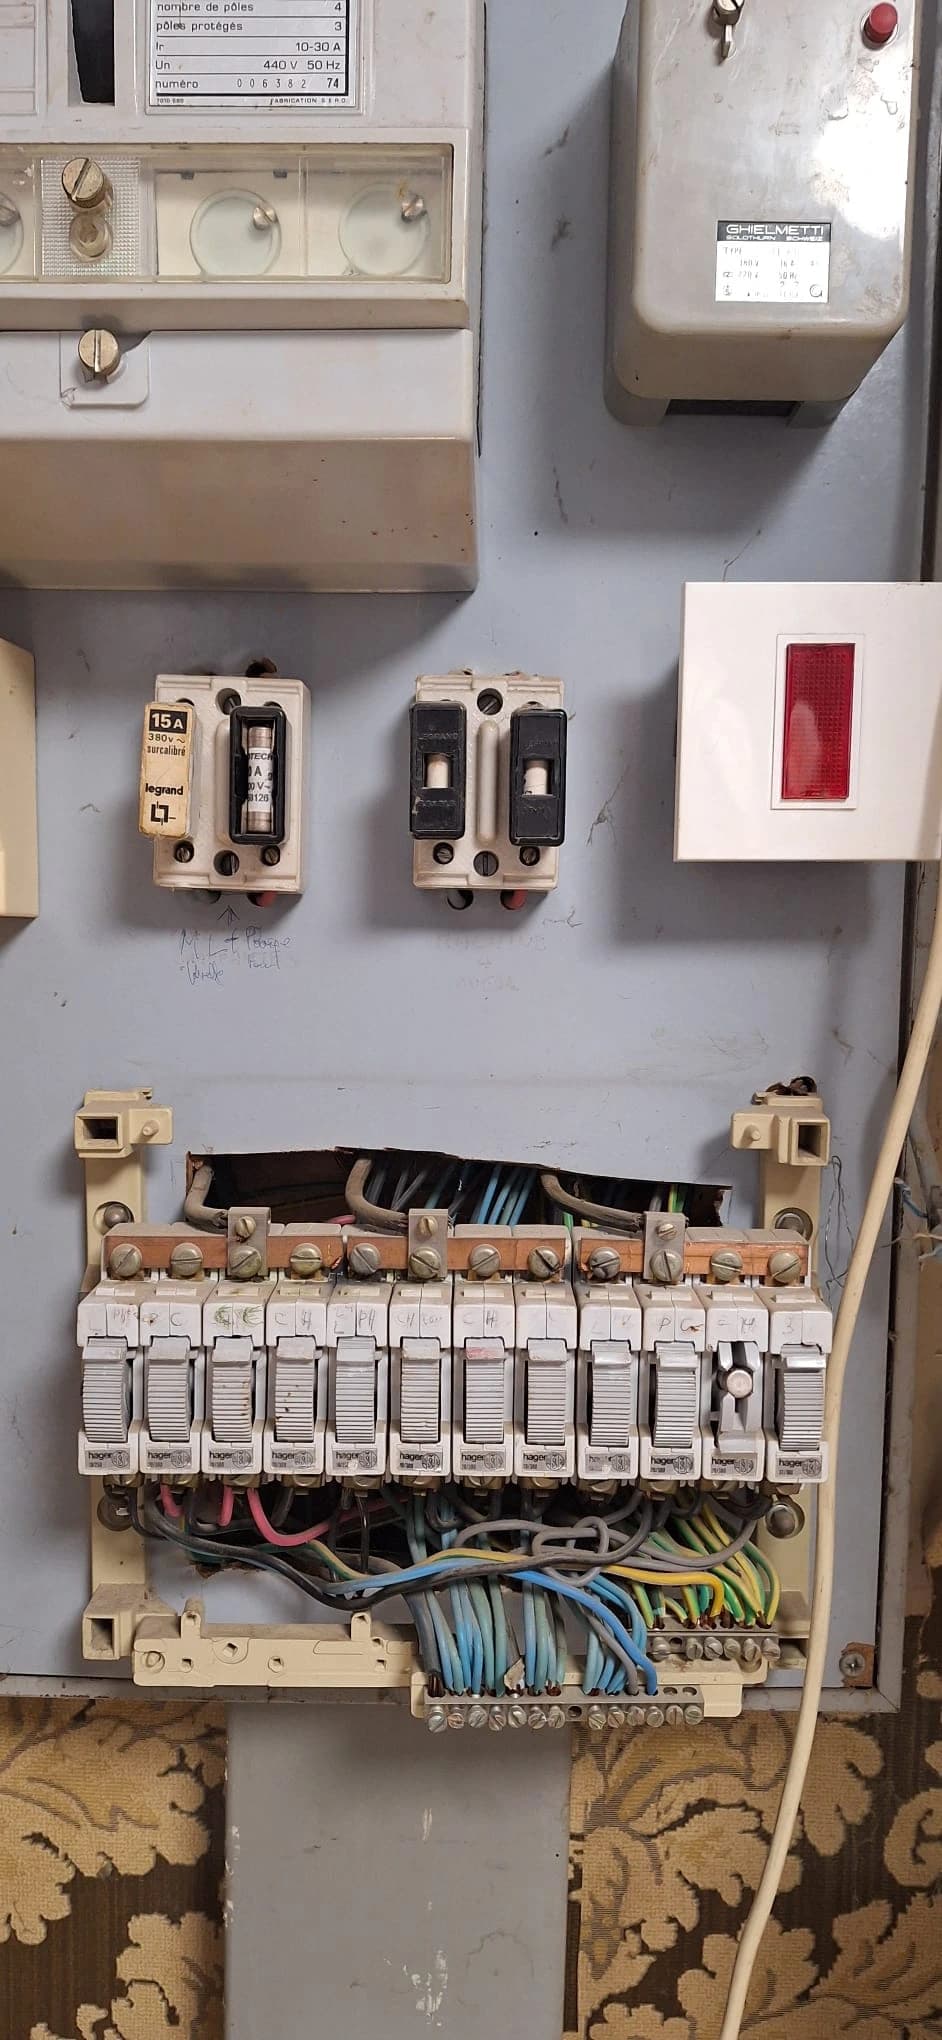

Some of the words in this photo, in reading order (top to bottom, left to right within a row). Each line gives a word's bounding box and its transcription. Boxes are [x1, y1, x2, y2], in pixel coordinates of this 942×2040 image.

[157, 2, 200, 11] nombre
[205, 2, 219, 11] de
[224, 2, 254, 14] pôles
[333, 3, 342, 11] 4
[156, 20, 186, 32] pôles
[191, 21, 243, 33] protégés
[334, 21, 342, 31] 3
[296, 42, 330, 52] 10-30
[333, 42, 341, 52] A
[155, 60, 171, 70] Un
[263, 60, 287, 70] 440
[290, 60, 298, 70] V
[307, 60, 323, 70] 50
[326, 60, 341, 70] Hz
[155, 79, 199, 89] numéro
[327, 77, 339, 89] 74
[269, 97, 318, 106] FABRICATION
[726, 224, 824, 236] GHIELMETTI
[147, 744, 186, 757] surcalibré
[145, 782, 184, 797] legrand
[147, 1451, 171, 1460] hager
[209, 1450, 233, 1460] hager
[271, 1450, 295, 1460] hager
[400, 1452, 423, 1461] hager
[461, 1452, 485, 1462] hager
[523, 1452, 546, 1462] hager
[650, 1455, 675, 1465] hager
[711, 1456, 735, 1466] hager
[778, 1458, 802, 1468] hager
